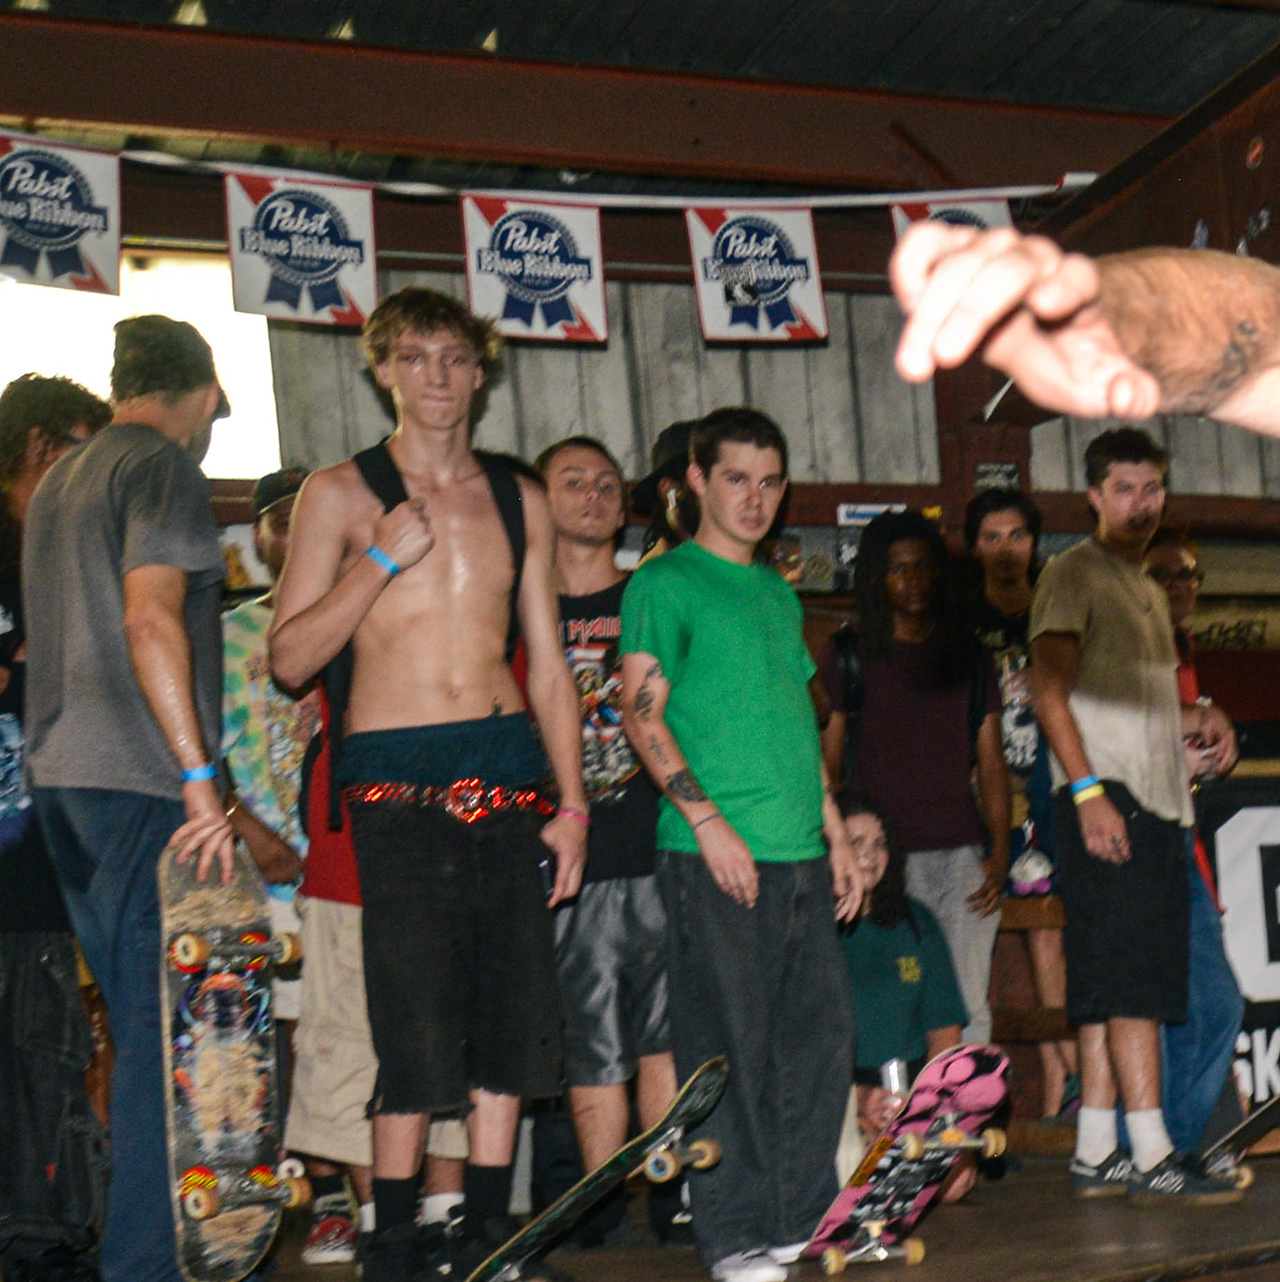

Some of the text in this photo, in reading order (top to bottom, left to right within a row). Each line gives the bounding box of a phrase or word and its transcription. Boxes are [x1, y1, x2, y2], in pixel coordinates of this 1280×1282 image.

[0, 160, 75, 200] Pabst
[29, 197, 105, 231] Ribbon
[263, 199, 331, 235] Pabst
[242, 227, 361, 266] Blue Ribbon
[496, 220, 562, 255] Pabst
[719, 226, 778, 258] Pabst
[480, 249, 591, 282] Blue Ribbon
